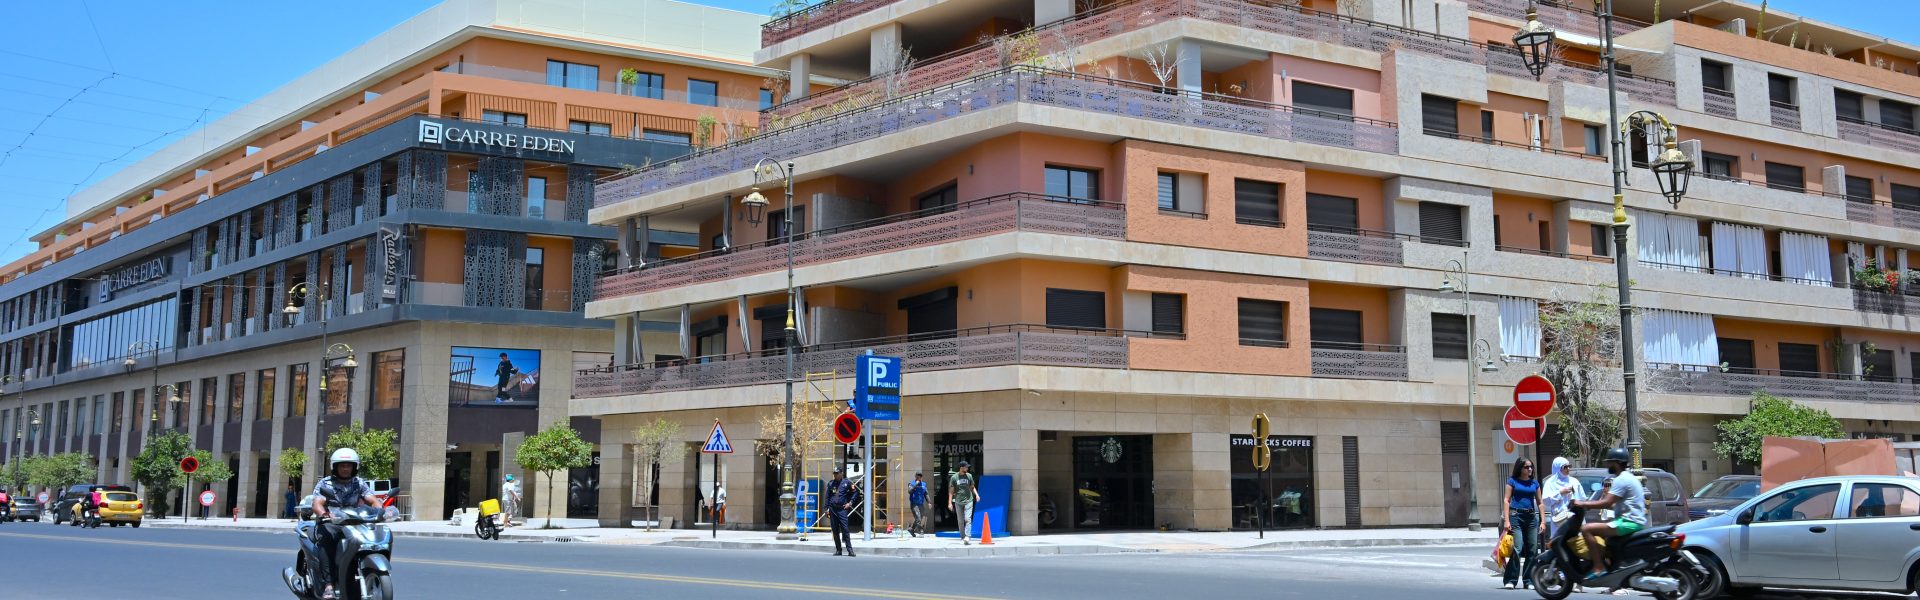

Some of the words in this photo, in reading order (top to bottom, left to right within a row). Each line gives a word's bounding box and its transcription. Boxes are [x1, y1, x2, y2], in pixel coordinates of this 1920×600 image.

[445, 127, 518, 148] CARRE
[522, 135, 575, 154] EDEN
[109, 265, 139, 292] CARRE
[140, 255, 166, 282] EDEN
[1281, 439, 1311, 447] COFFEE
